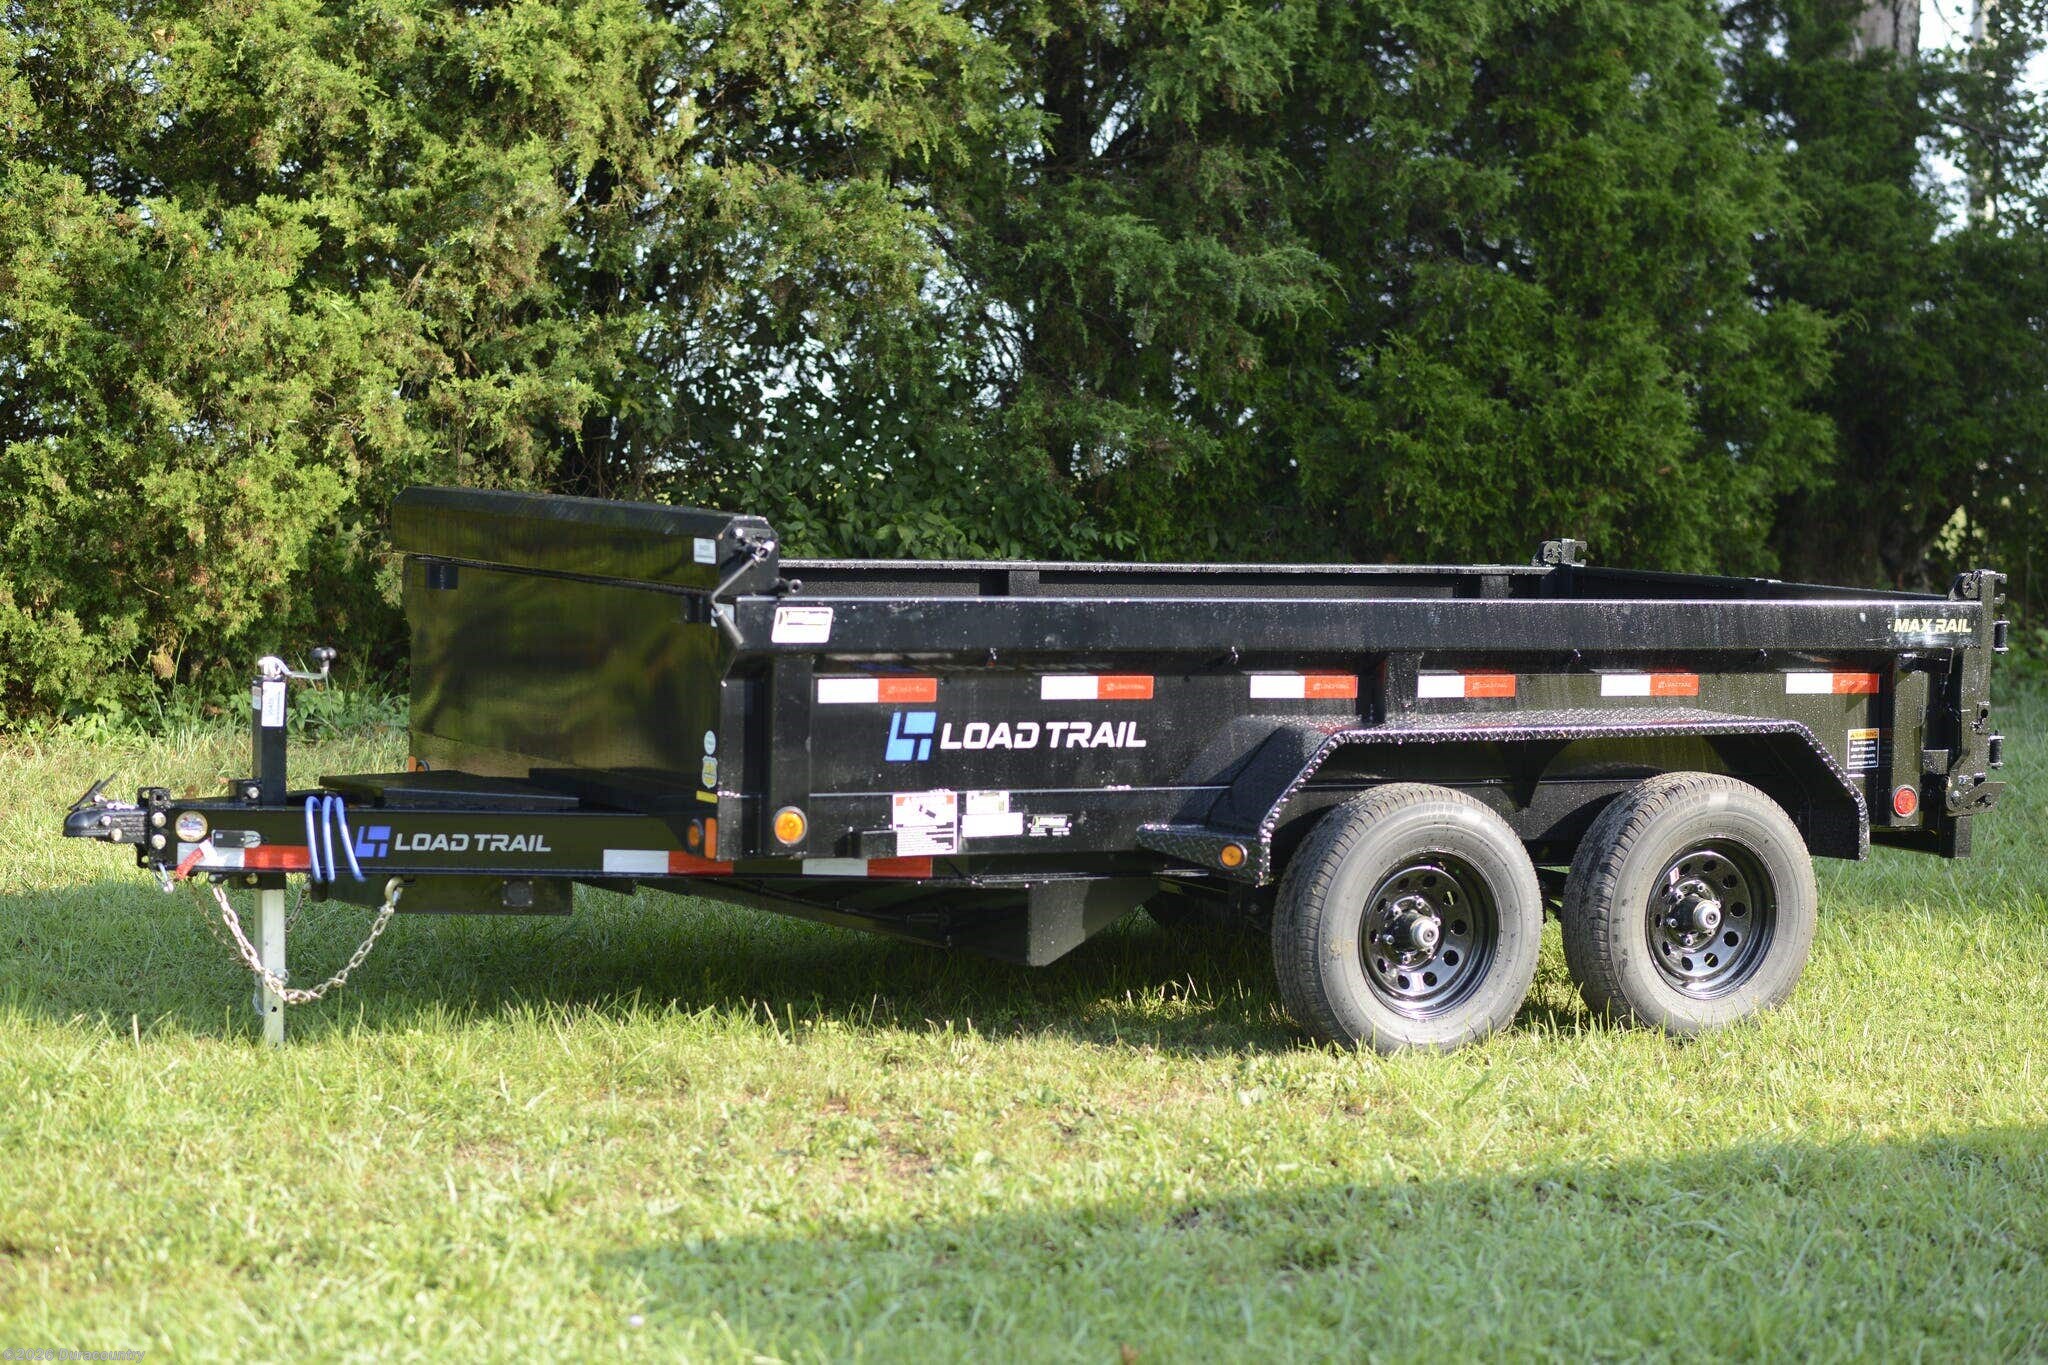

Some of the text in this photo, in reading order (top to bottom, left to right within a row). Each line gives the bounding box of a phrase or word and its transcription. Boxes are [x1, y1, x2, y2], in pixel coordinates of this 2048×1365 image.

[1894, 618, 1972, 633] MAX RAIL
[939, 721, 1041, 750] LOAD
[1045, 721, 1147, 749] TRAIL
[394, 832, 471, 852] LOAD
[473, 833, 552, 853] TRAIL
